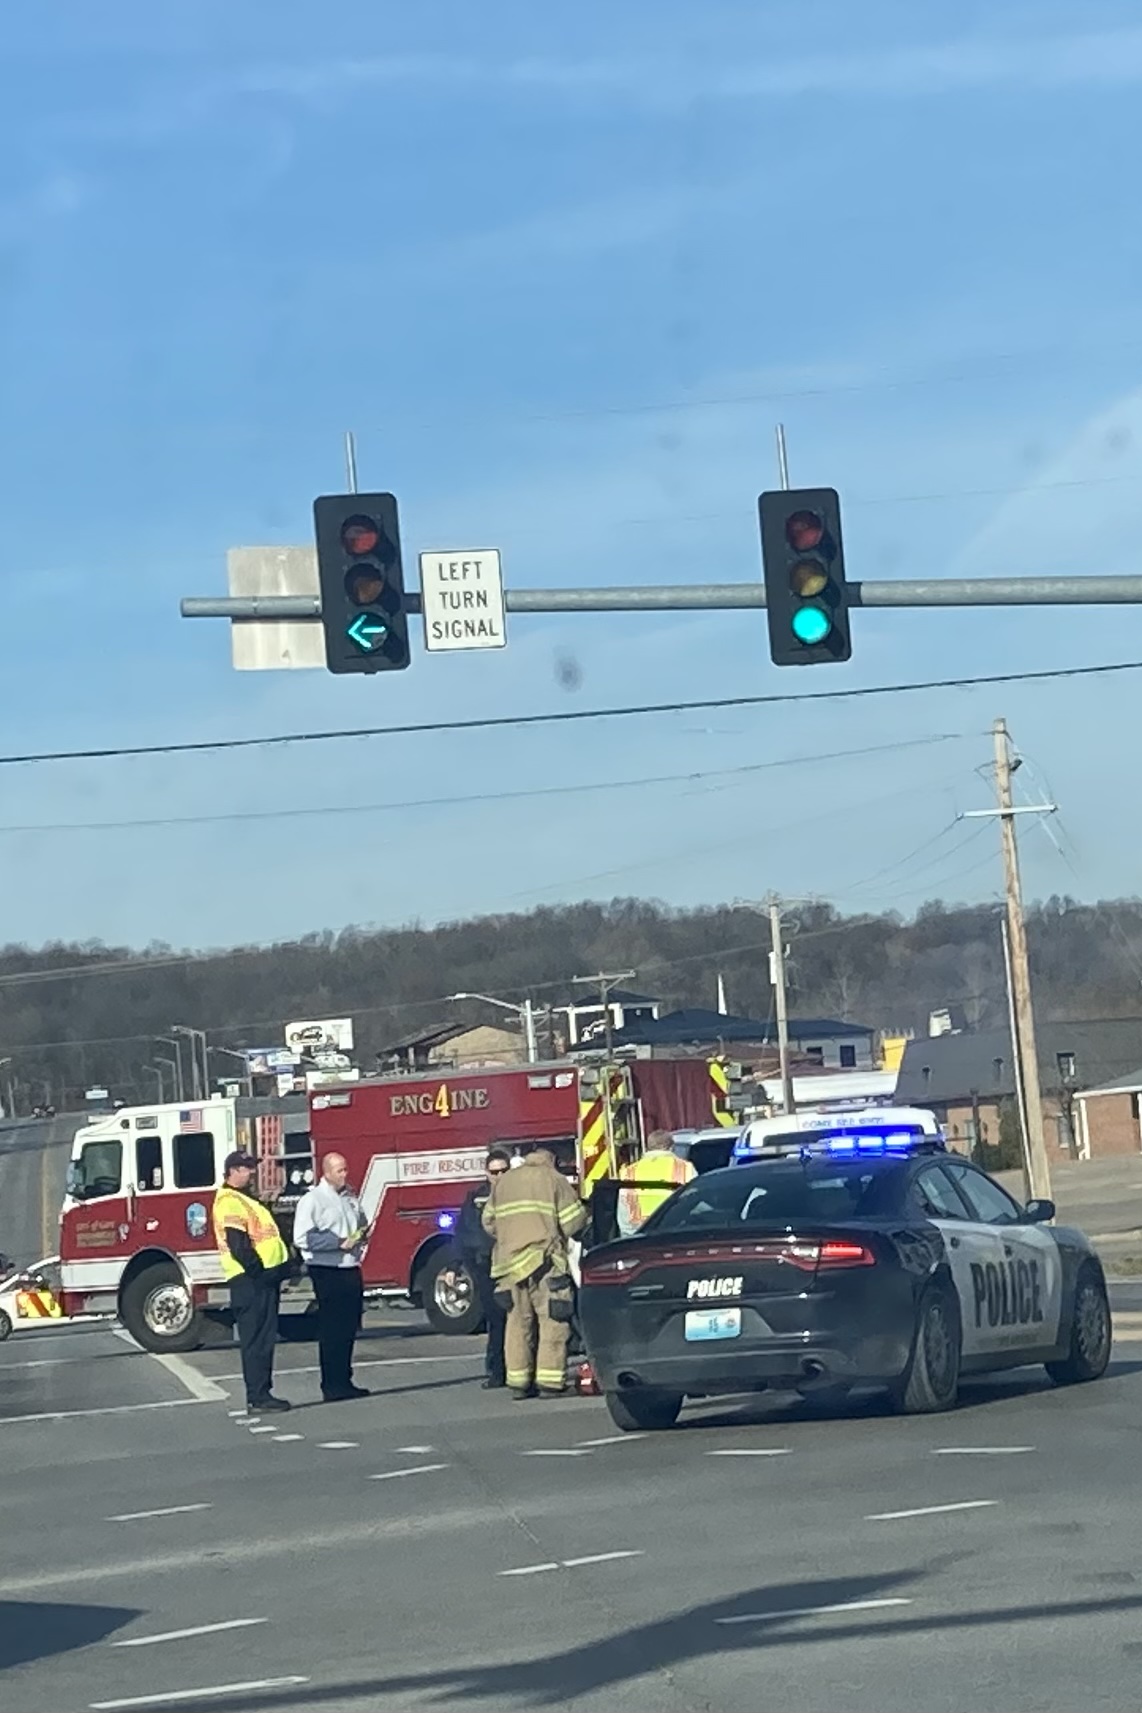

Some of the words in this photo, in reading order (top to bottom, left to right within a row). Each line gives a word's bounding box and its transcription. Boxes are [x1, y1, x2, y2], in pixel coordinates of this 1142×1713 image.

[438, 561, 482, 581] LEFT
[438, 589, 488, 610] TURN
[432, 618, 499, 639] SIGNAL
[686, 1276, 743, 1299] POLICE
[970, 1259, 1043, 1329] POLICE
